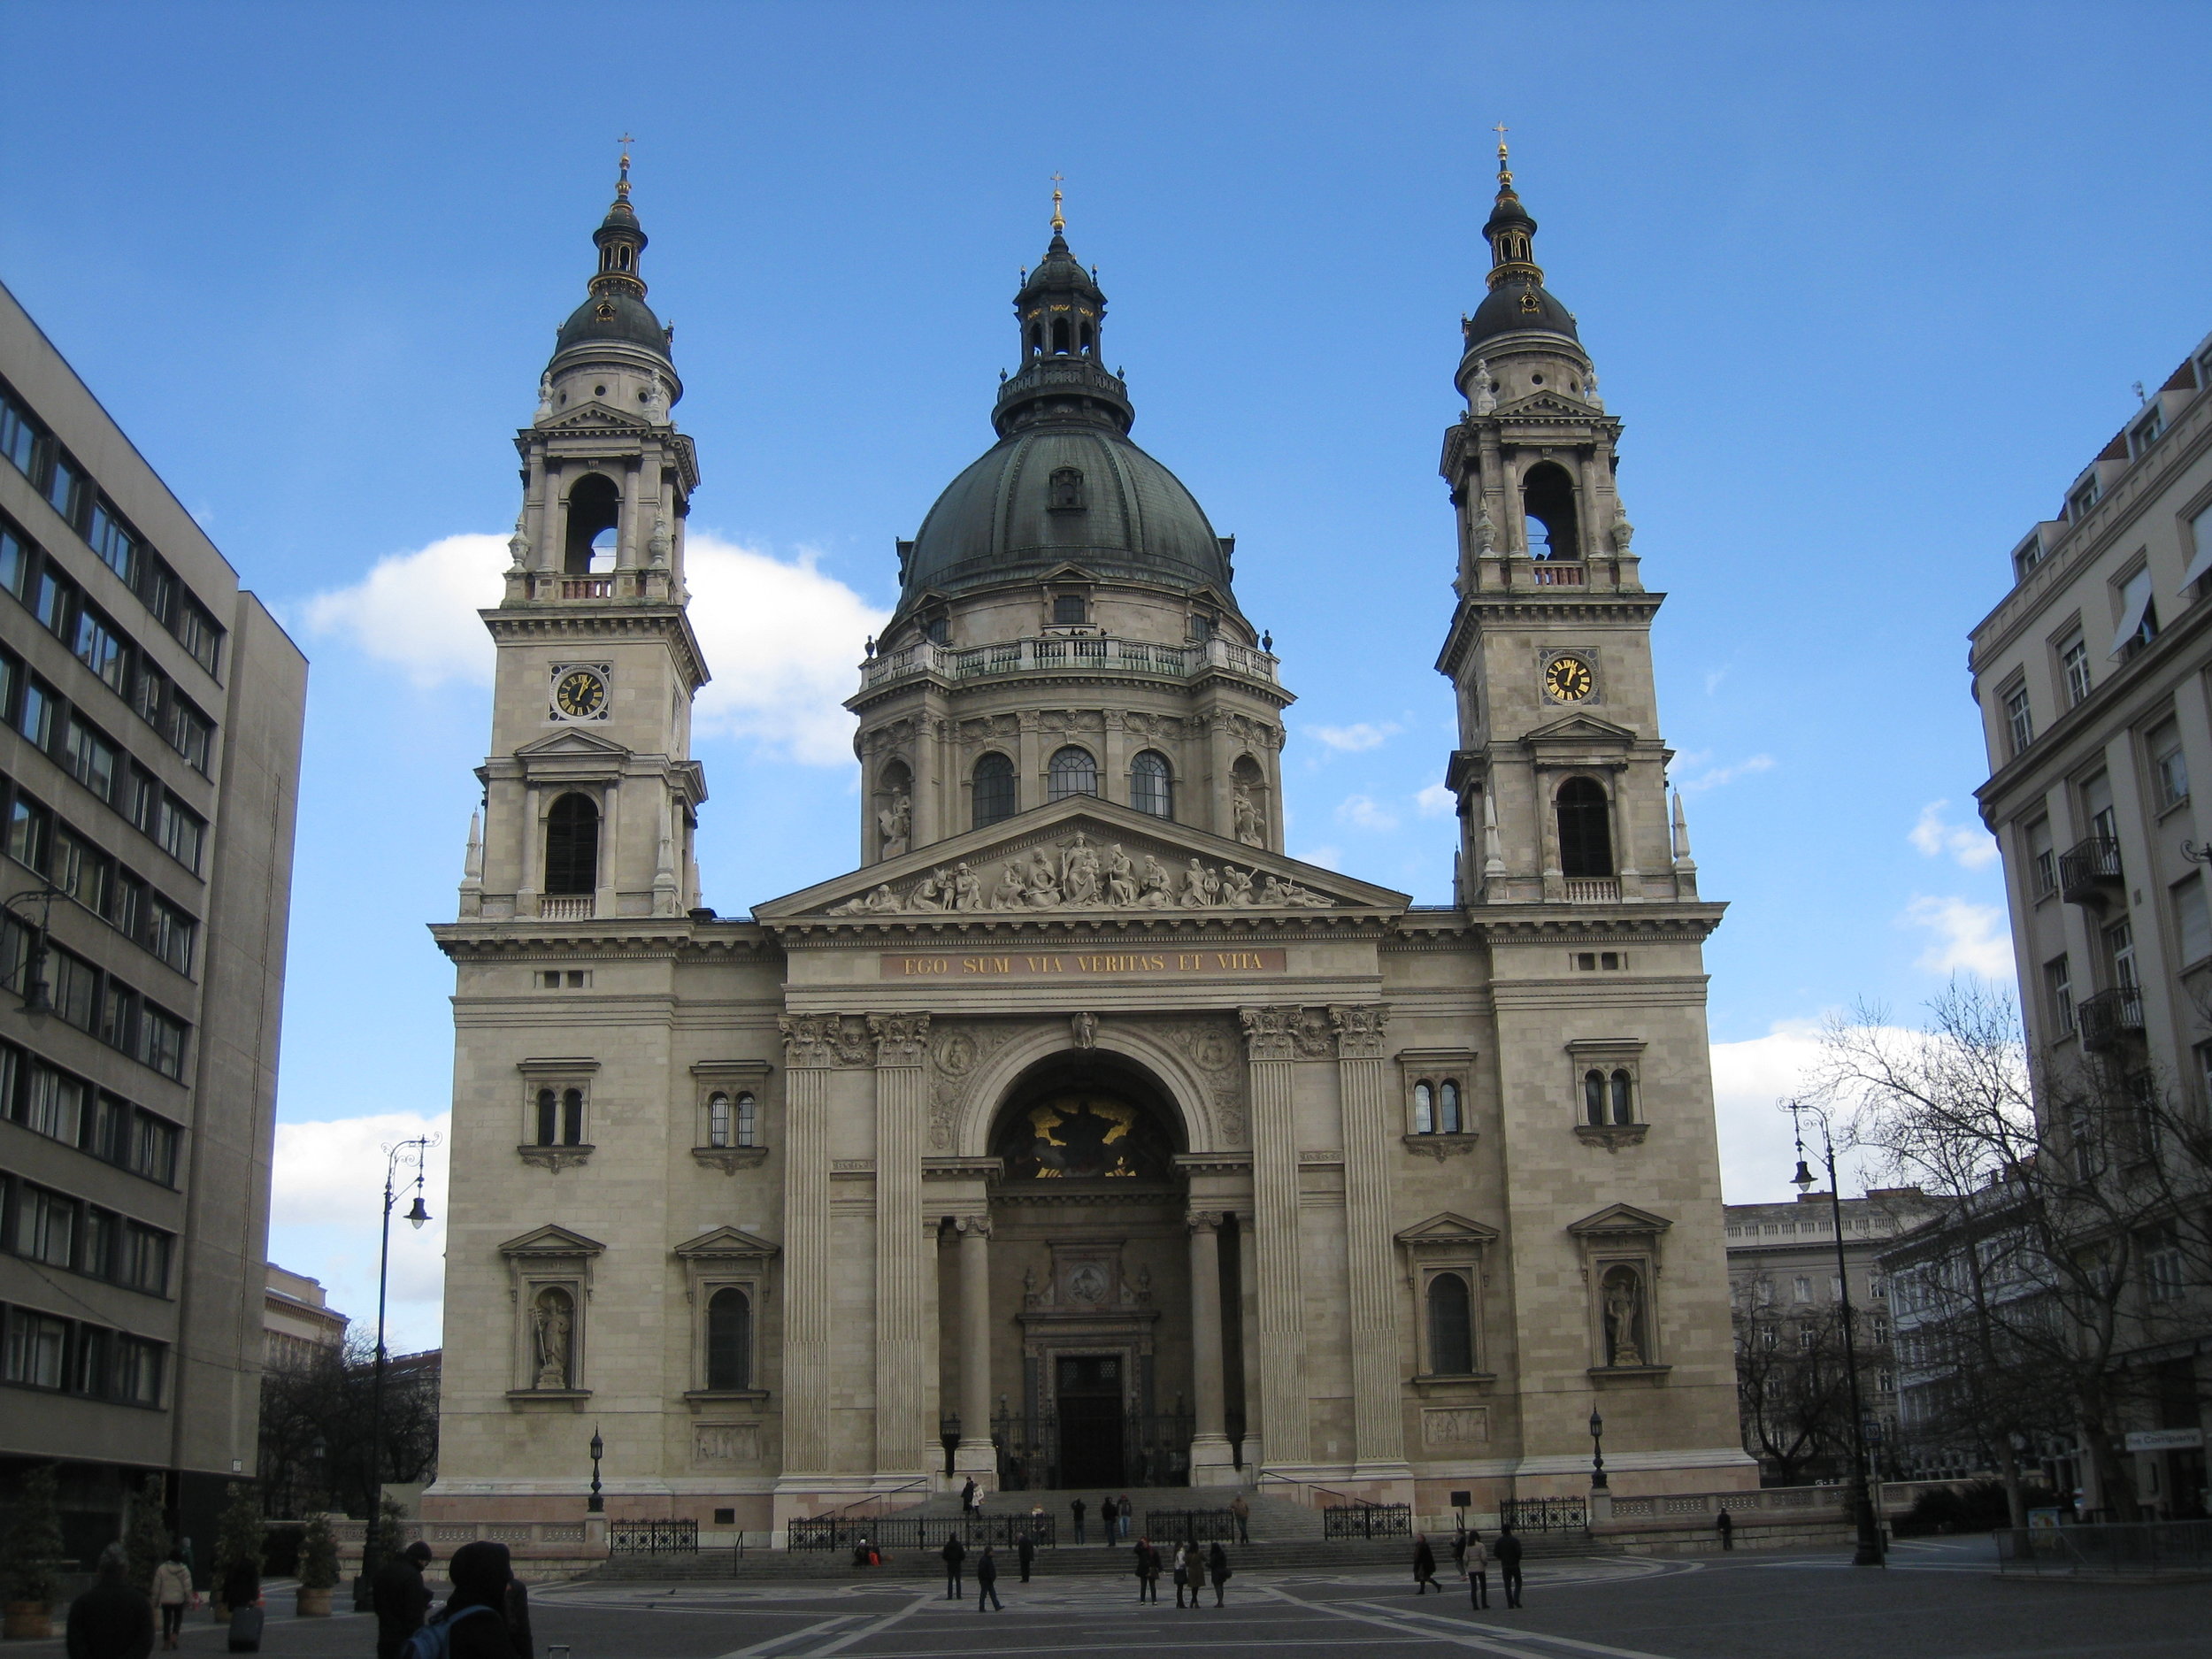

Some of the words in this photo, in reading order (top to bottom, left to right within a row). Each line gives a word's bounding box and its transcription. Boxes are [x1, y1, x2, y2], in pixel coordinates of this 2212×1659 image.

[904, 958, 948, 974] EGO
[963, 956, 1010, 973] SUM
[1027, 956, 1063, 972] VIA
[1077, 955, 1165, 973] VERITAS
[1178, 954, 1203, 971] ET
[1217, 953, 1263, 970] VITA
[2144, 1434, 2196, 1445] Company
